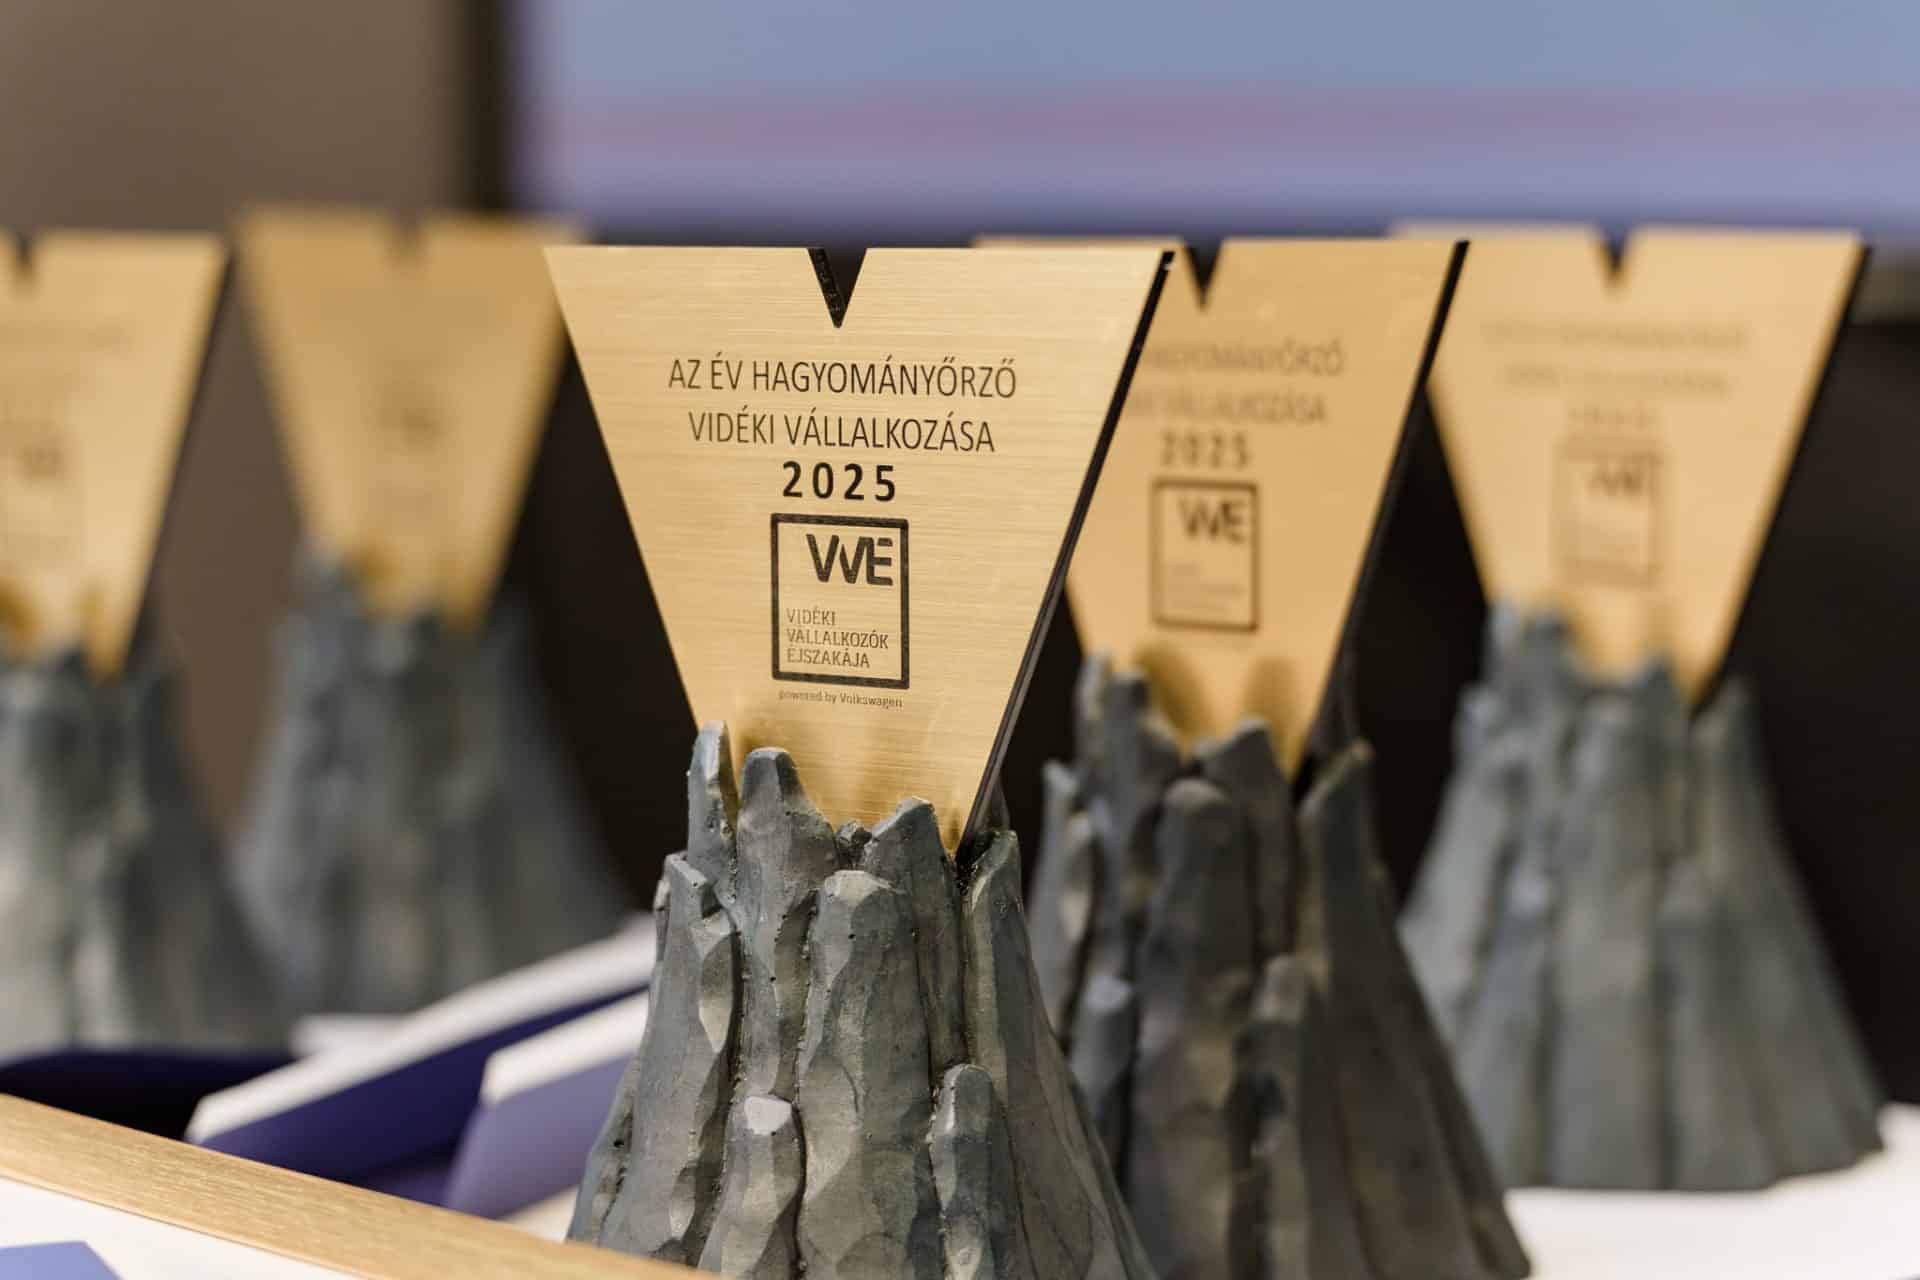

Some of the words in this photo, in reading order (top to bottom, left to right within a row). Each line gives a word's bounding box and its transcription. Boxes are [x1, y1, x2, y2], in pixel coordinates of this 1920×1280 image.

[668, 358, 701, 390] AZ
[711, 351, 743, 390] ÉV
[752, 354, 1017, 399] HAGYOMÁNYŐRZŐ
[688, 404, 775, 445] VIDÉKI
[784, 406, 996, 452] VÁLLALKOZÁSA
[1161, 430, 1250, 468] 2025
[782, 460, 896, 502] 2025
[786, 605, 836, 626] VIDÉKI
[787, 643, 870, 668] ÉJSZAKÁJA
[825, 691, 837, 704] by
[840, 692, 903, 709] Volkswagen
